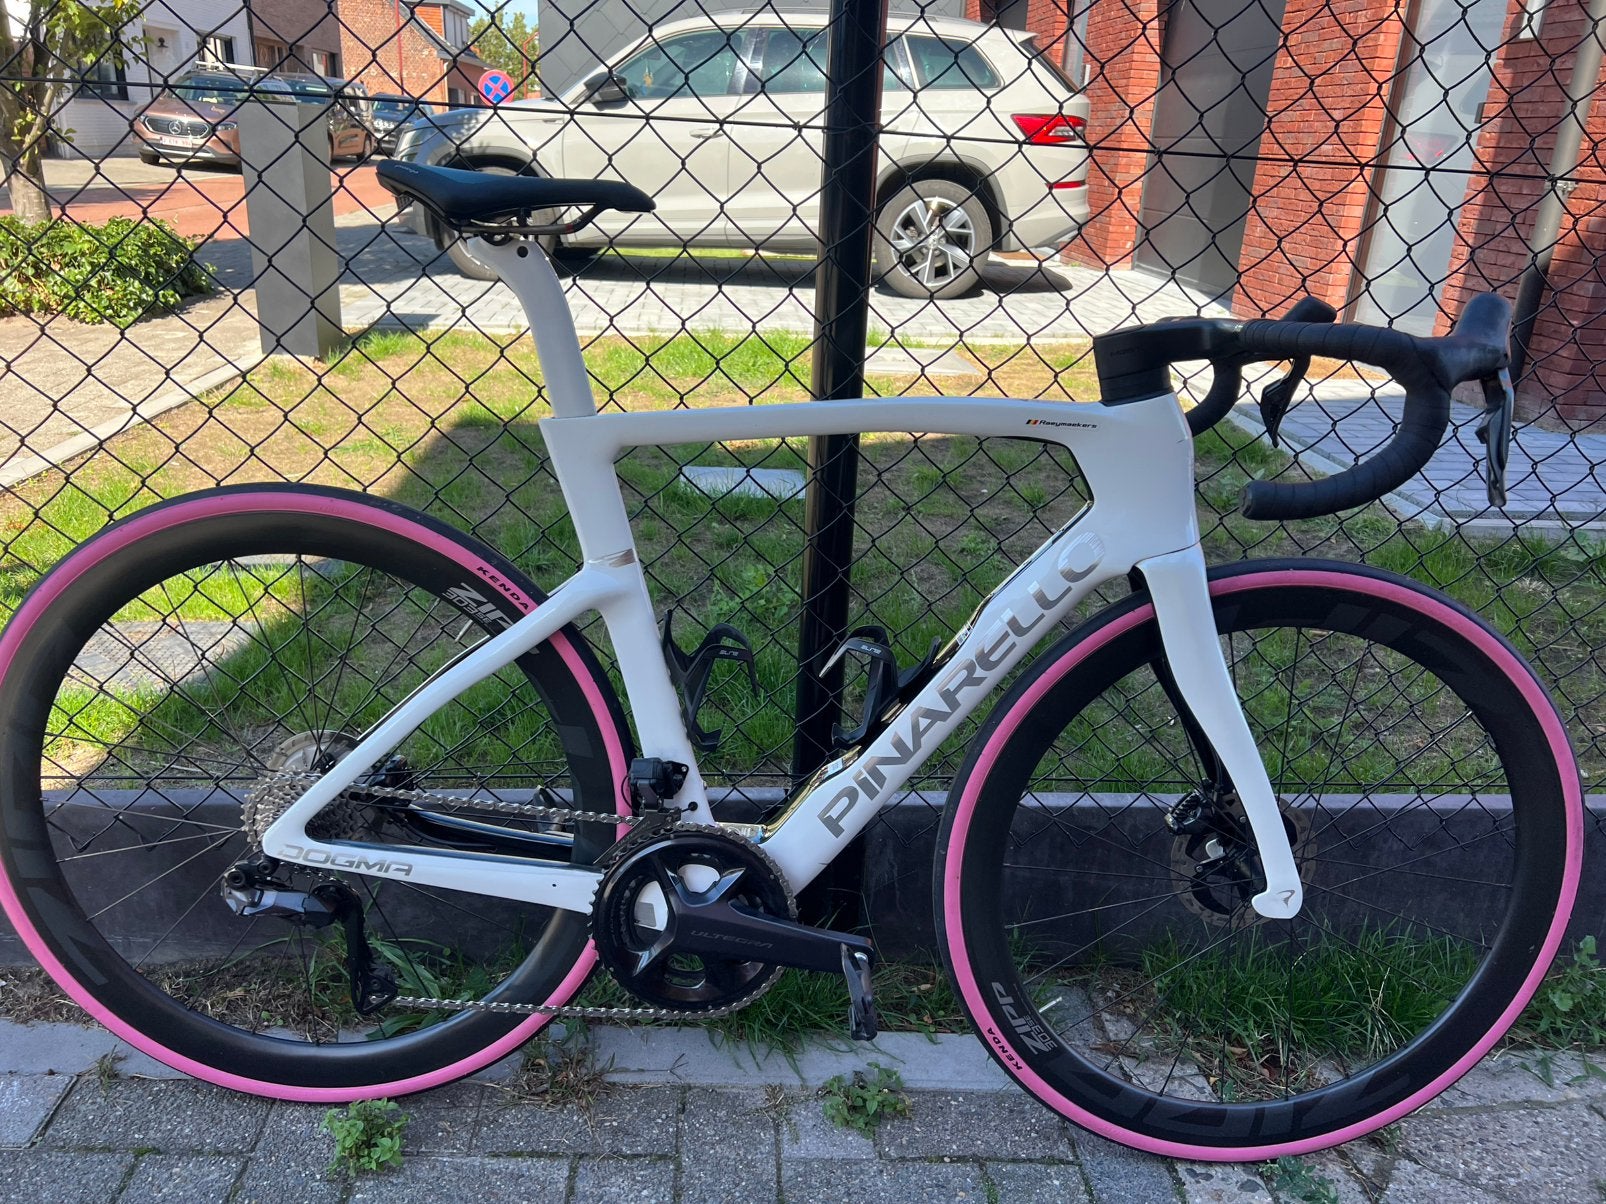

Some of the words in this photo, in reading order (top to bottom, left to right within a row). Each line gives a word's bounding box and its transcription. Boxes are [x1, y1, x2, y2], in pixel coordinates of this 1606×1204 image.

[447, 582, 519, 632] ZIP
[476, 566, 530, 611] KENDA
[816, 531, 1106, 839] PINARELLO
[277, 843, 413, 877] DOGMA
[689, 929, 774, 949] ULTEGRA
[991, 981, 1050, 1056] ZIPP
[986, 1026, 1024, 1071] KENDA
